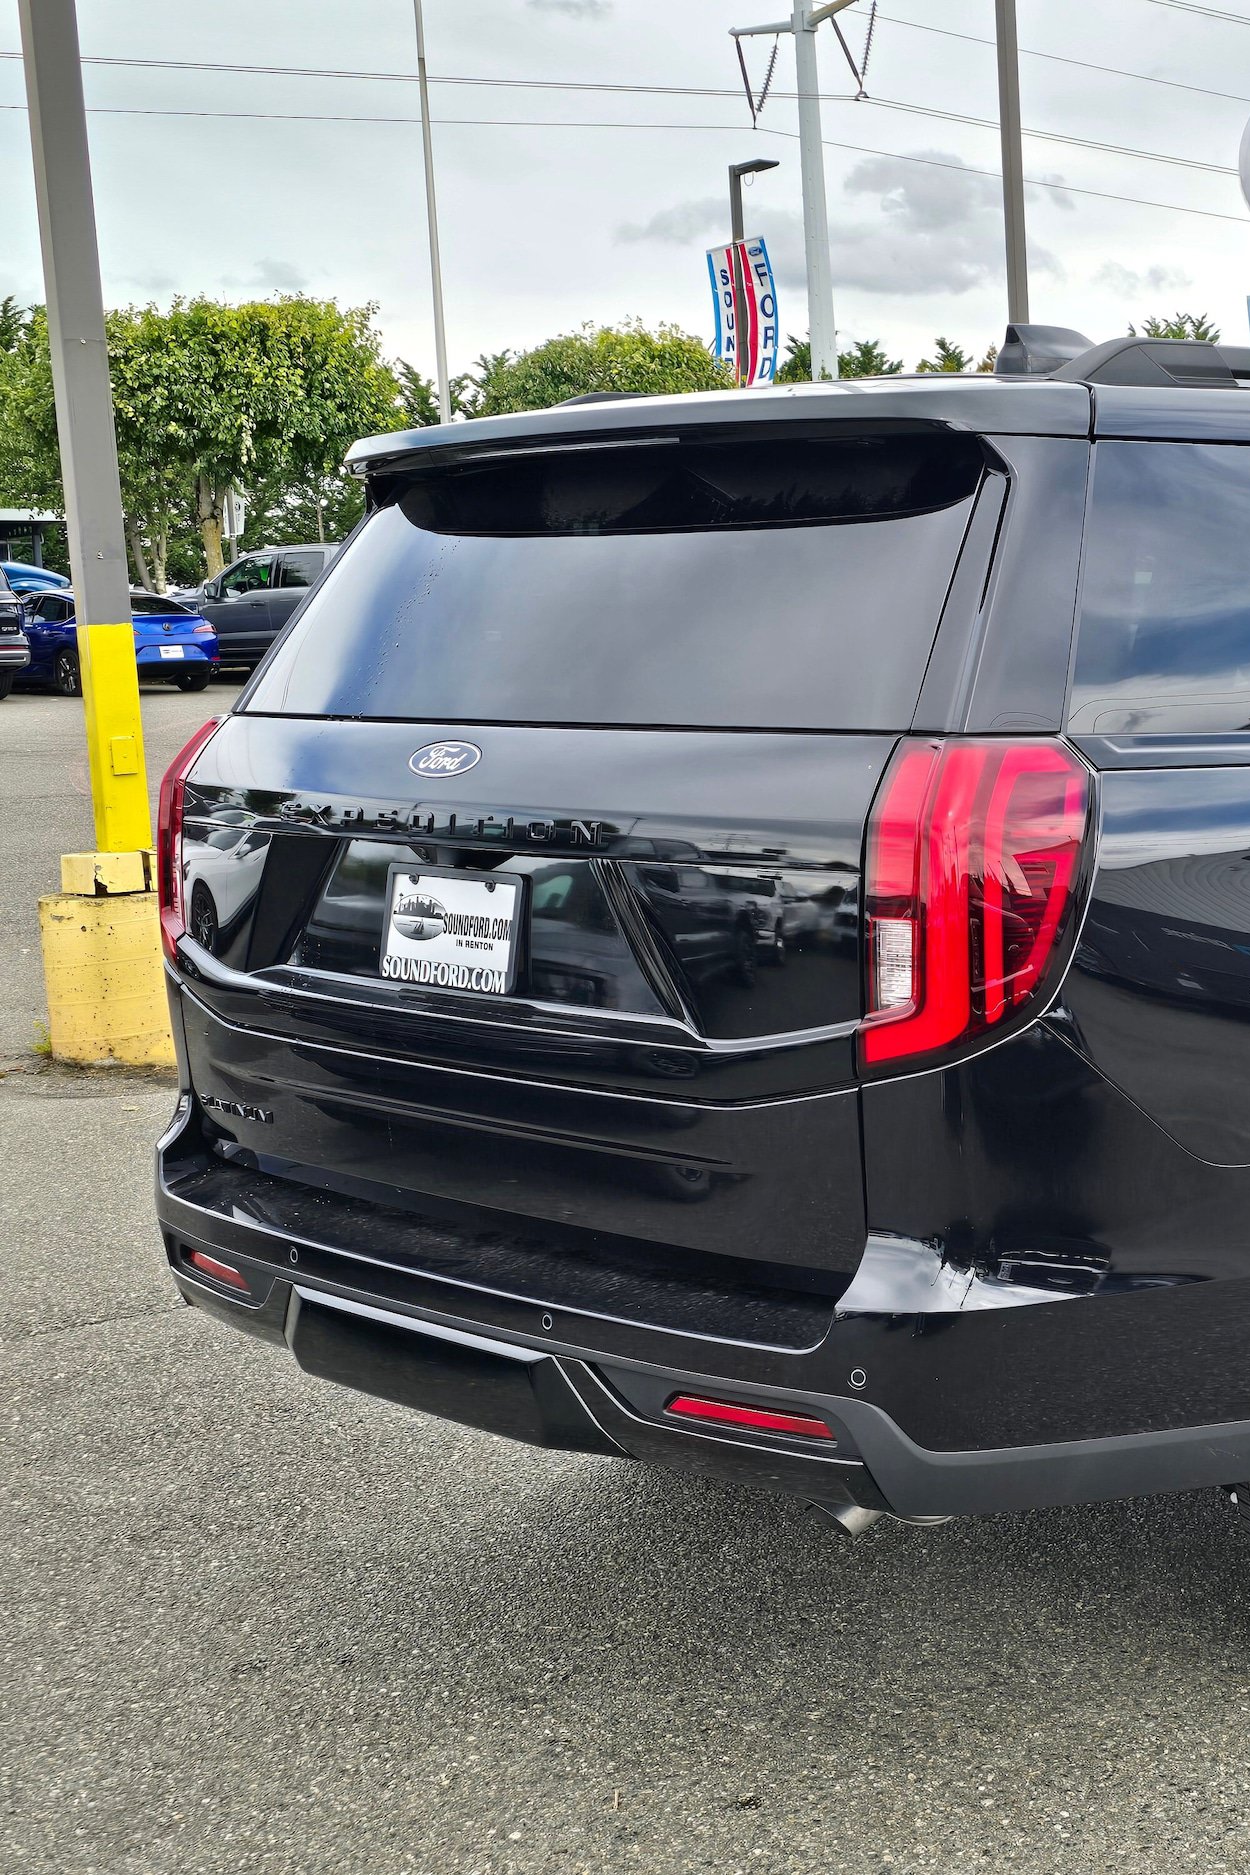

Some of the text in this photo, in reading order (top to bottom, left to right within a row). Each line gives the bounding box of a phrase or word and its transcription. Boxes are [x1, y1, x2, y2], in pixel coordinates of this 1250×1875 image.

[754, 263, 774, 378] FORD
[418, 745, 468, 770] Ford
[442, 912, 512, 941] SOUNDFORD.COM
[455, 938, 494, 951] IN RENTON
[382, 954, 506, 995] SOUNDFORD.COM
